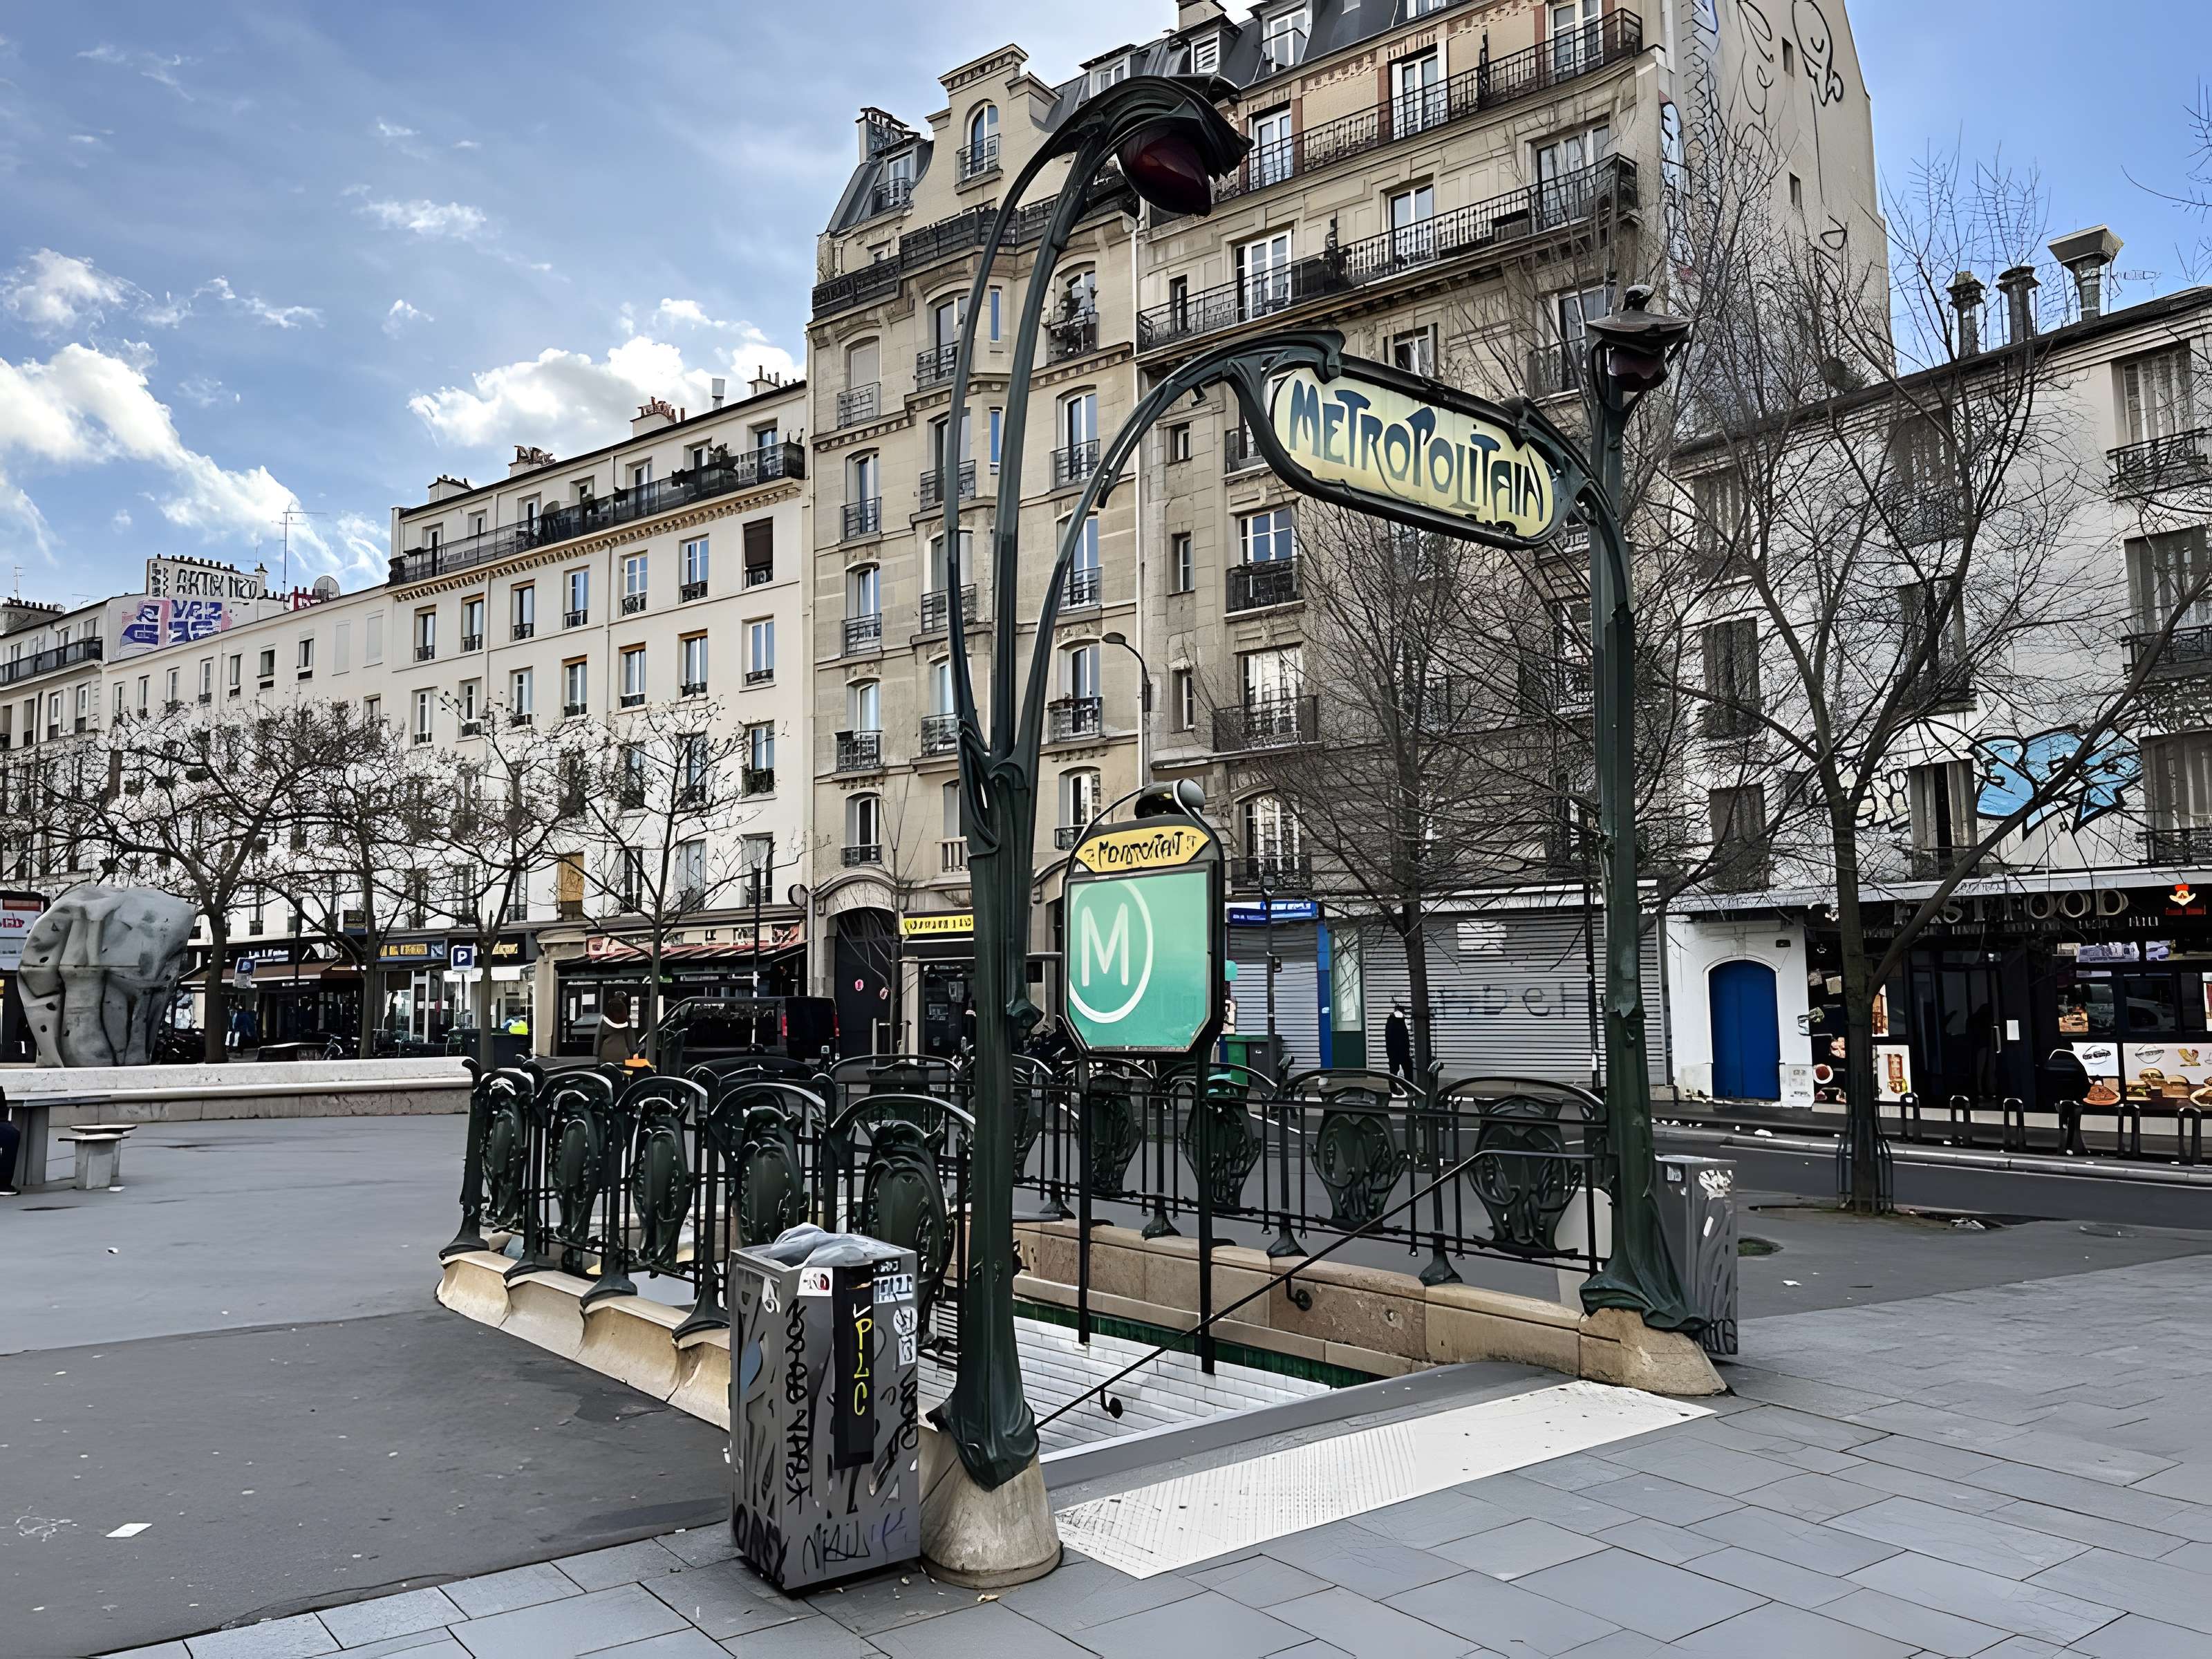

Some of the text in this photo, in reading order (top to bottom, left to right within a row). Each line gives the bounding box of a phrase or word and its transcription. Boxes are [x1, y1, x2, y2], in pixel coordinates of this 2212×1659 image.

[1288, 379, 1544, 522] METROPOLITAIN
[457, 950, 468, 964] P
[1081, 903, 1129, 987] M
